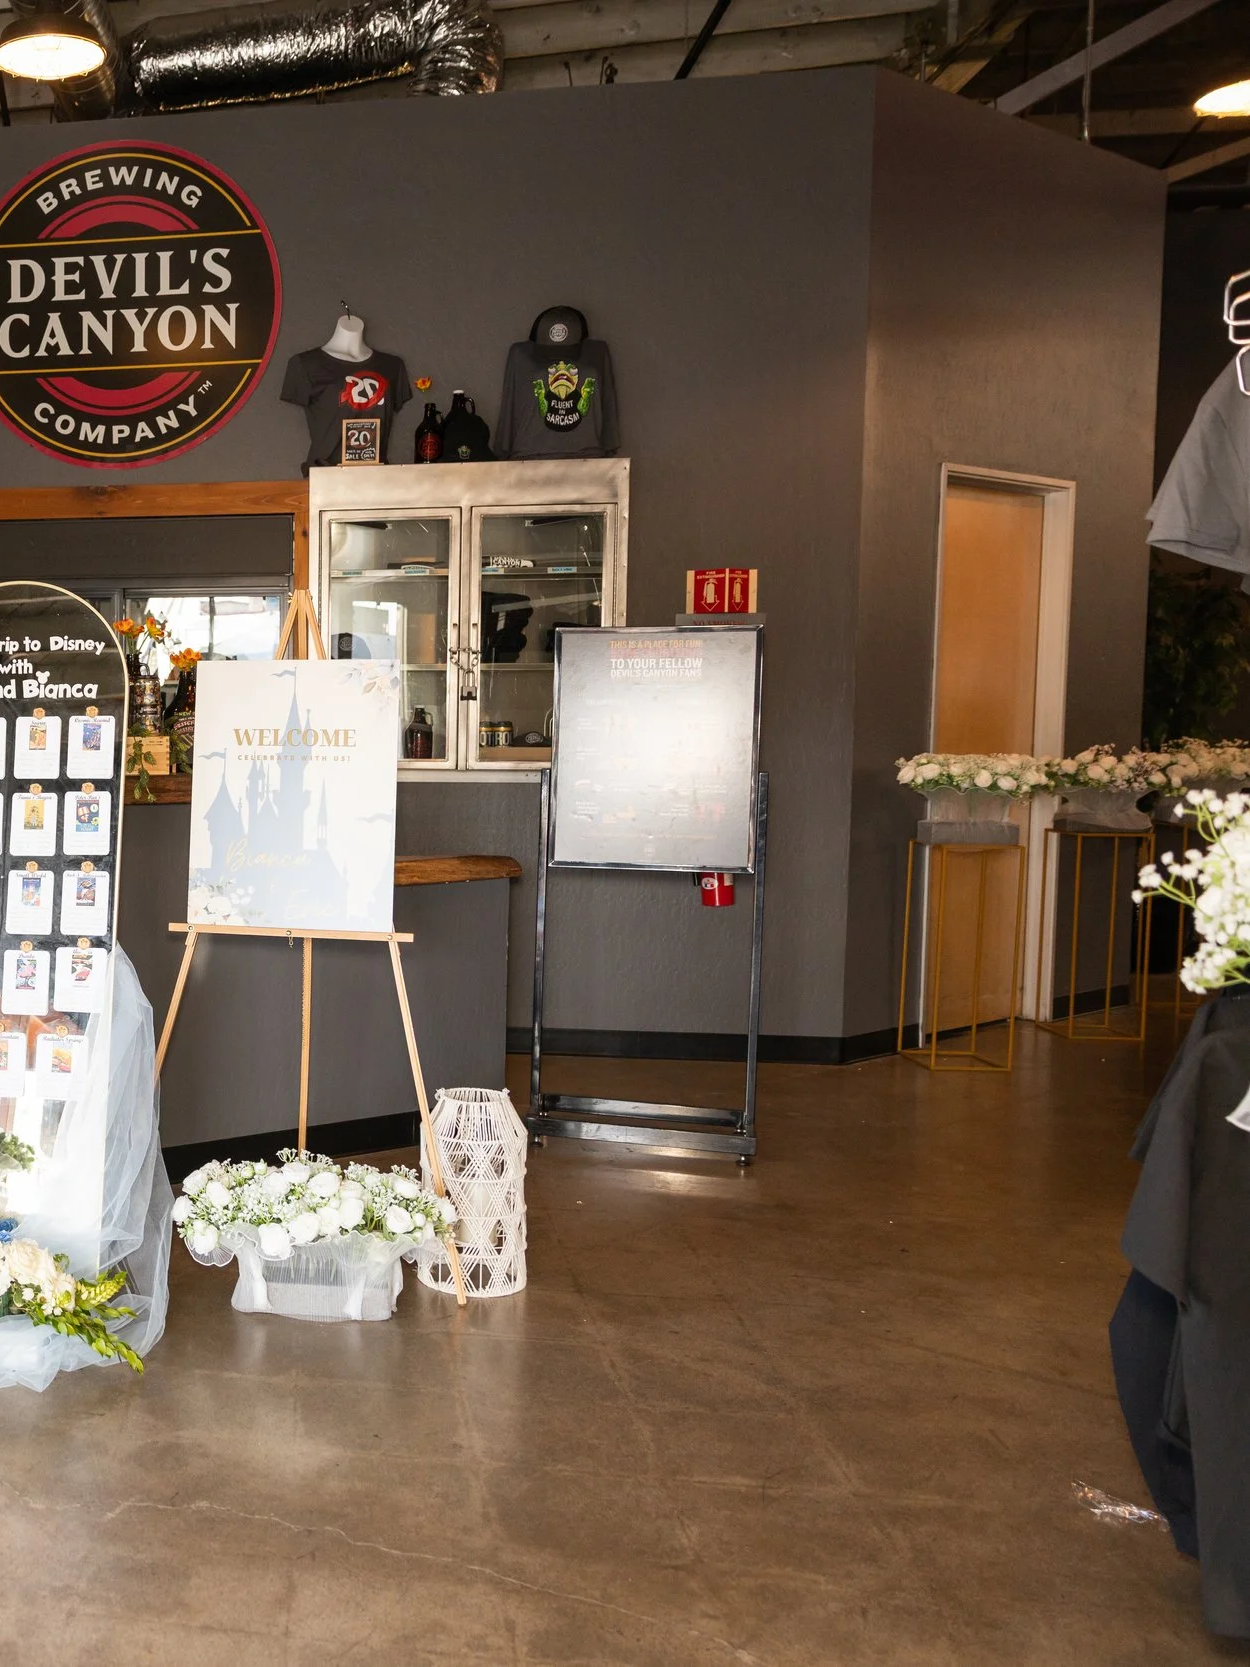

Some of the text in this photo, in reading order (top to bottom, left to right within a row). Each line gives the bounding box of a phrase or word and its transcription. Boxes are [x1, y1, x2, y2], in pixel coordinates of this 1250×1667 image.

[36, 165, 203, 215] BREWING
[7, 248, 232, 304] DEVIL'S
[550, 400, 574, 410] FLUENT
[33, 394, 199, 445] COMPANY
[546, 413, 579, 426] SARCASM
[347, 430, 371, 447] 20
[24, 636, 41, 652] to
[49, 635, 105, 656] Disney
[610, 640, 627, 649] THIS
[629, 640, 636, 649] IS
[636, 640, 643, 649] A
[644, 640, 668, 649] PLACE
[669, 640, 684, 649] FOR
[611, 658, 702, 668] TO YOUR FELLOW
[611, 669, 702, 678] DEVIL'S CANYON FANS
[22, 673, 98, 700] Bianca
[233, 728, 356, 747] WELCOME
